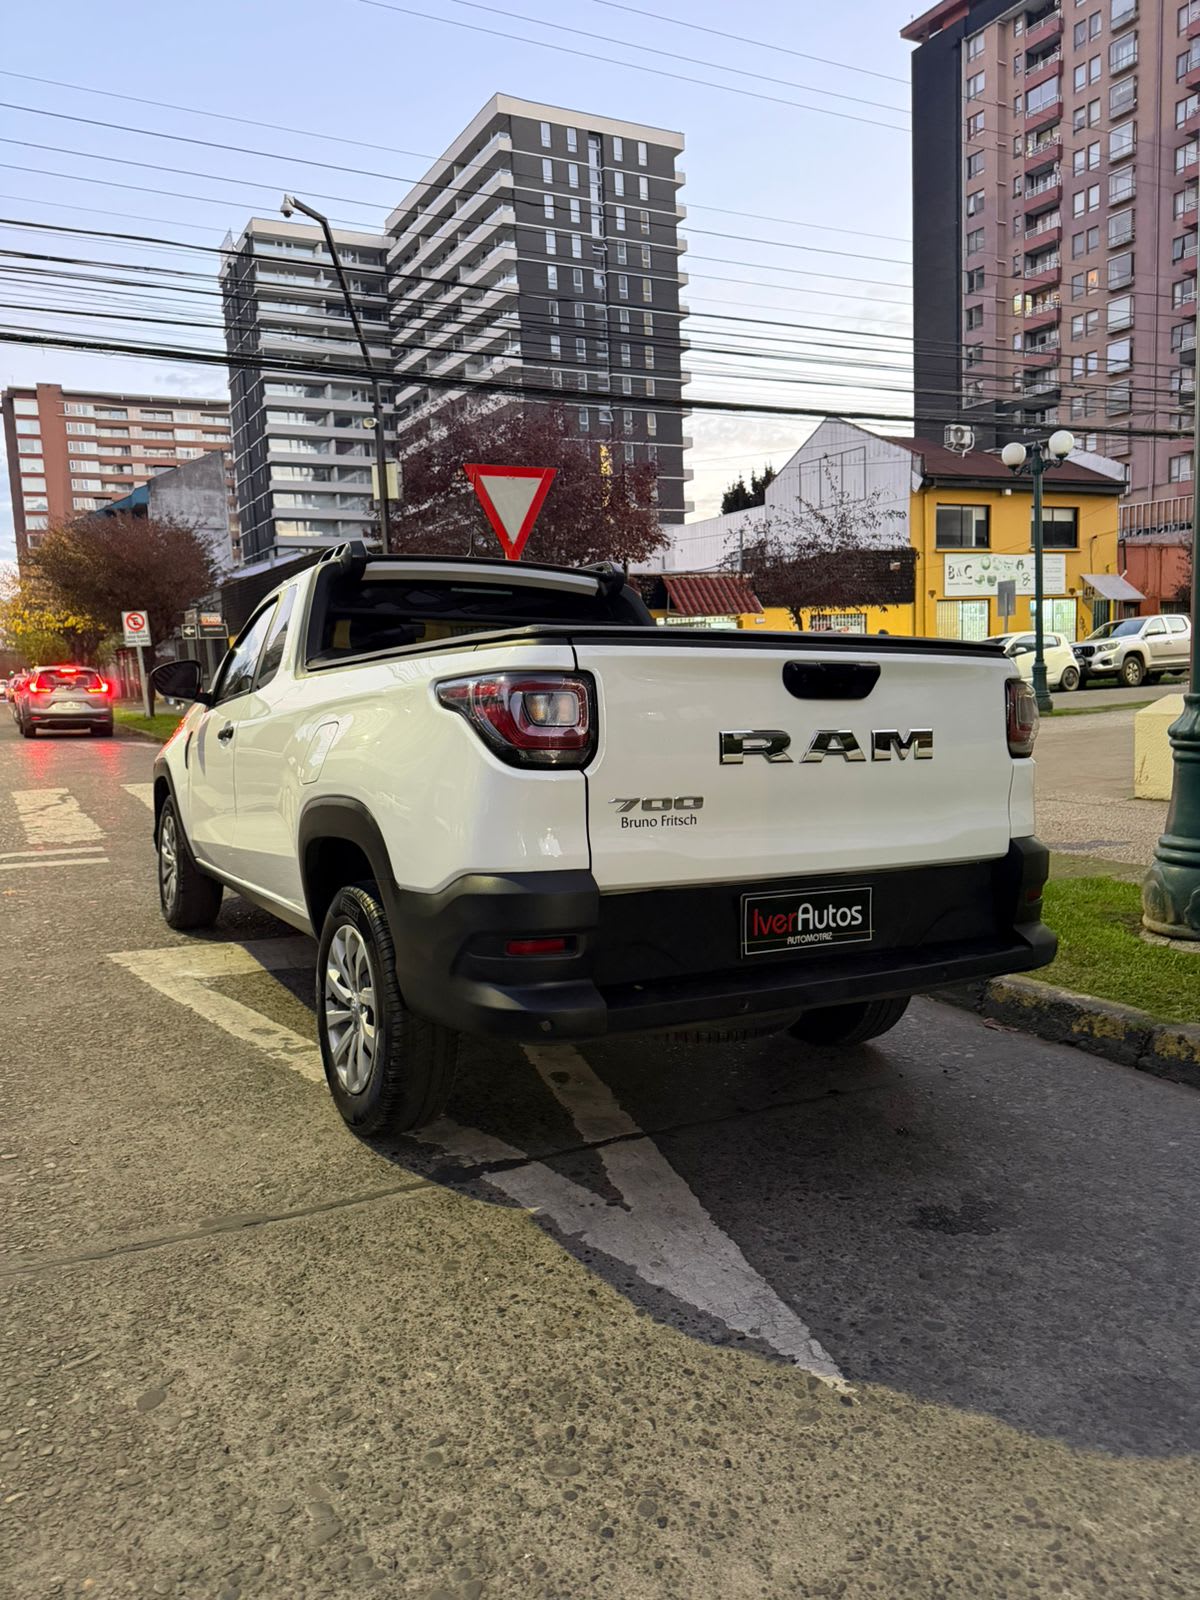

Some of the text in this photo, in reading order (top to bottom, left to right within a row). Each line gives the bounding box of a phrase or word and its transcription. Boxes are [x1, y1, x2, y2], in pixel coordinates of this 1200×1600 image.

[719, 728, 934, 765] RAM
[608, 796, 704, 813] 700
[621, 813, 697, 829] Bruno Fritsch
[753, 902, 863, 937] IverAutos
[787, 931, 833, 945] AUTOMOTRIZ
